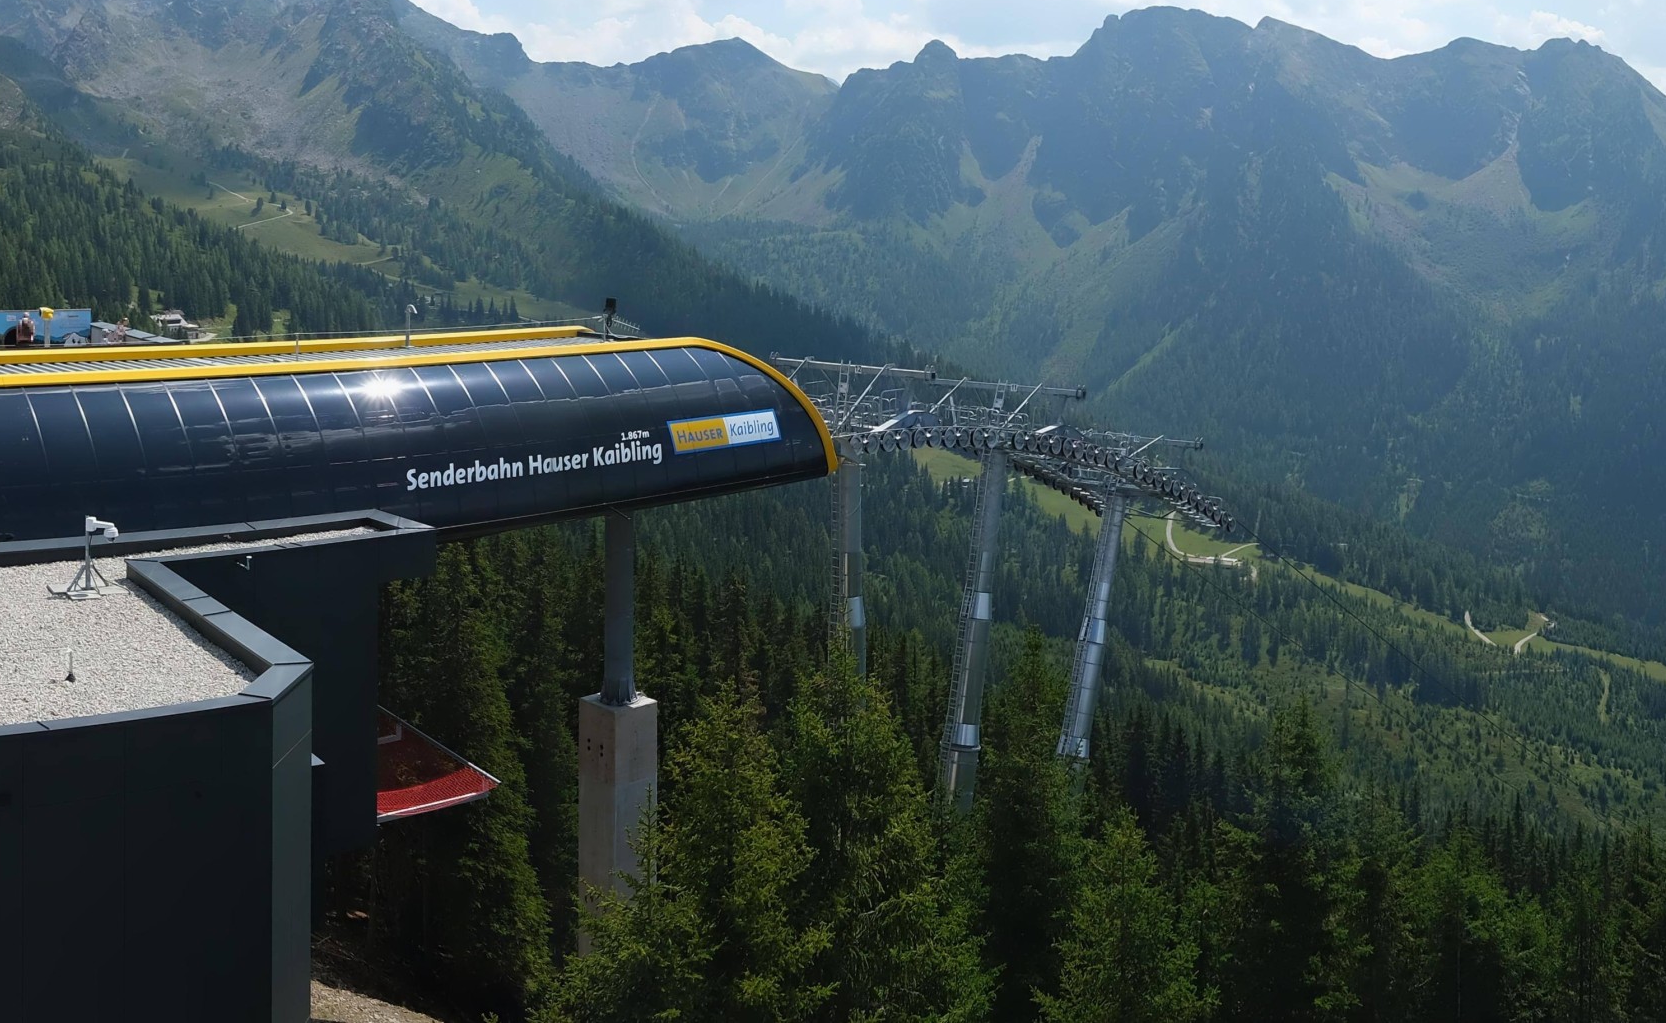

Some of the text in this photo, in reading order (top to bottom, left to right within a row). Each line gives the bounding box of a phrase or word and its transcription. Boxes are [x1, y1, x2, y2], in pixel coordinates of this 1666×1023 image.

[620, 430, 650, 441] 1.867m
[676, 418, 774, 444] HAUSER Kaibling
[407, 440, 662, 491] Senderbahn Hauser Kaibling
